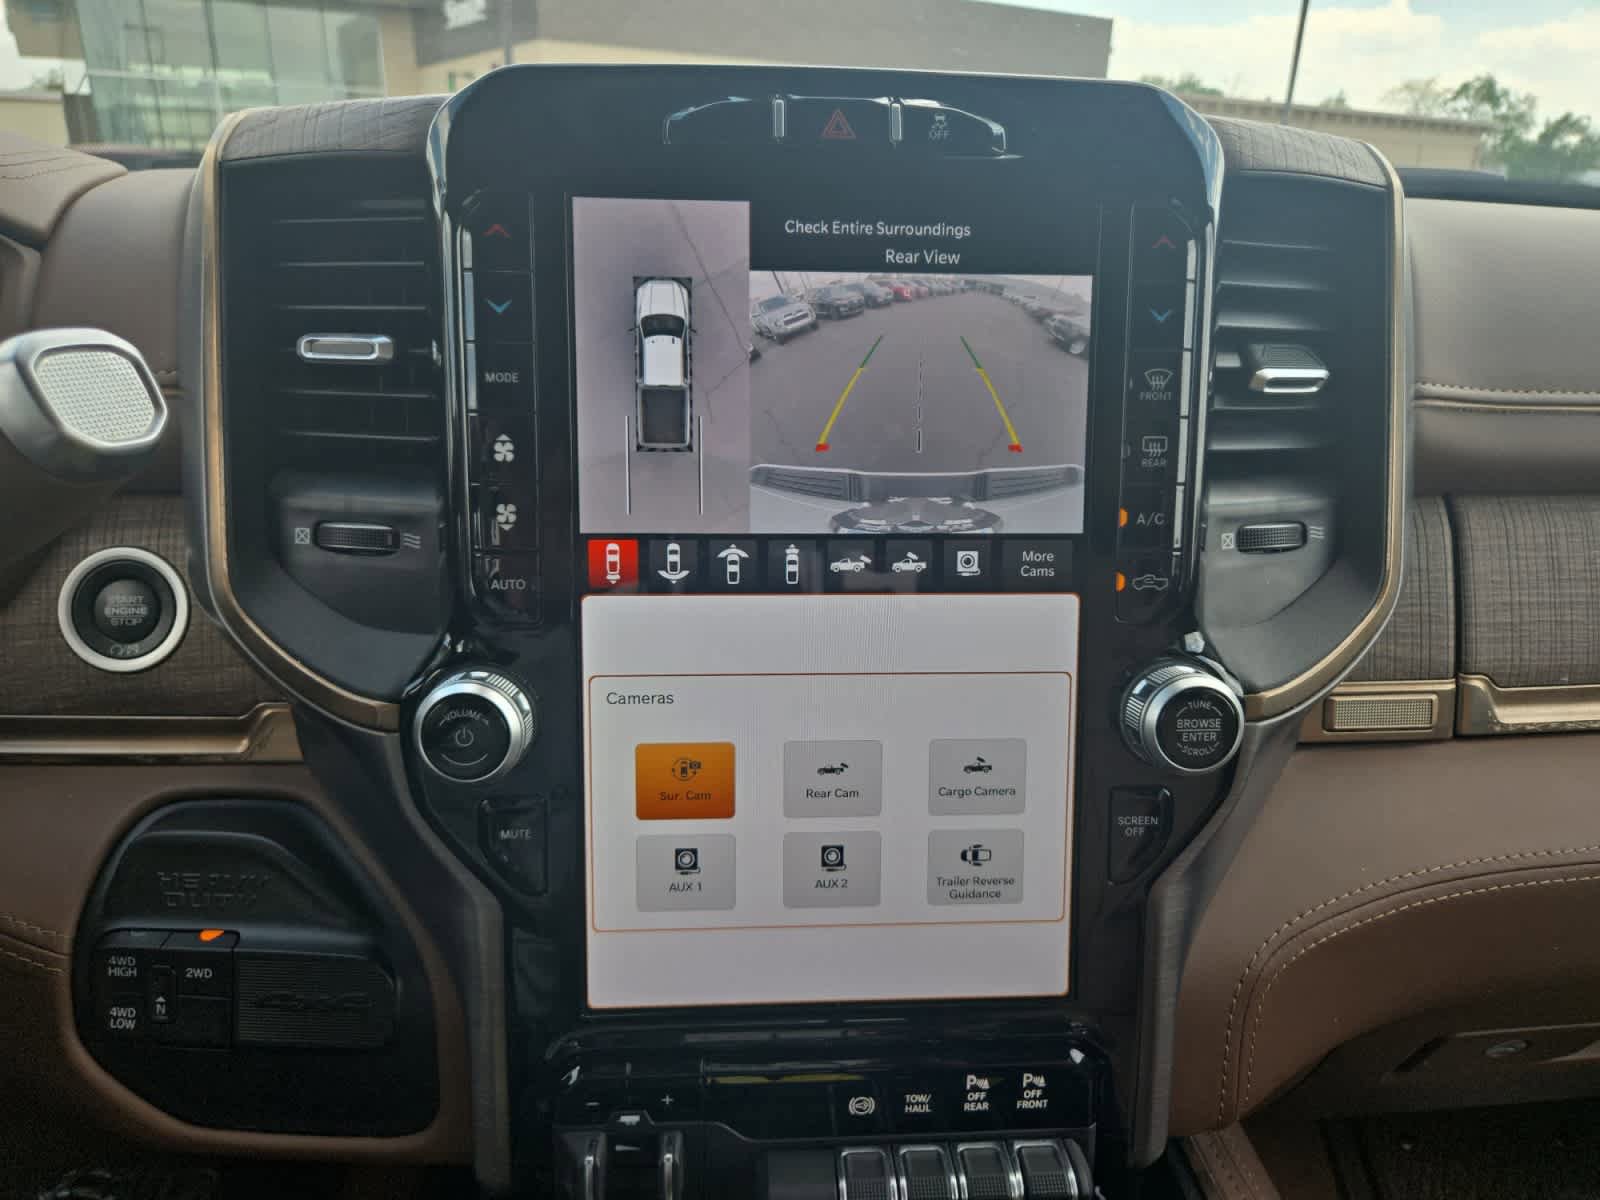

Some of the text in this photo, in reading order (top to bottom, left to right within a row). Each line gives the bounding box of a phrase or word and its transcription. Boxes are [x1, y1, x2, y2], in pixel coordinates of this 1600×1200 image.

[928, 129, 950, 141] OFF
[784, 219, 971, 240] Check Entire Surroundings
[885, 249, 961, 265] Rear View
[485, 372, 519, 383] MODE
[1140, 391, 1172, 401] FRONT
[1140, 458, 1167, 468] REAR
[1136, 512, 1165, 525] A/C
[1022, 550, 1055, 562] More
[1020, 564, 1055, 577] Cams
[490, 579, 526, 590] AUTO
[103, 606, 148, 616] ENGINE
[110, 617, 143, 627] STOP
[606, 690, 674, 706] Cameras
[1188, 700, 1212, 711] TUNE
[446, 708, 482, 722] VOLUME
[1176, 718, 1222, 729] BROWSE
[1182, 732, 1217, 743] ENTER
[1182, 744, 1217, 757] SCROLL
[660, 790, 712, 801] Sur. Cam
[805, 788, 860, 799] Rear Cam
[938, 785, 1016, 799] Cargo Camera
[1117, 815, 1158, 826] SCREEN
[500, 829, 531, 840] MUTE
[1124, 827, 1145, 837] OFF
[814, 879, 848, 889] AUX 2
[936, 875, 1015, 887] Trailer Reverse
[668, 881, 694, 893] AUX
[949, 887, 1002, 900] Guidance
[108, 956, 136, 967] 4WD
[108, 966, 138, 978] HIGH
[185, 967, 213, 979] 2WD
[109, 1007, 137, 1019] 4WD
[155, 1003, 166, 1016] N
[110, 1018, 137, 1030] LOW
[905, 1093, 932, 1104] TOW/
[967, 1091, 987, 1101] OFF
[1023, 1089, 1043, 1099] OFF
[904, 1104, 931, 1113] HAUL
[963, 1102, 990, 1112] REAR
[1016, 1099, 1048, 1110] FRONT
